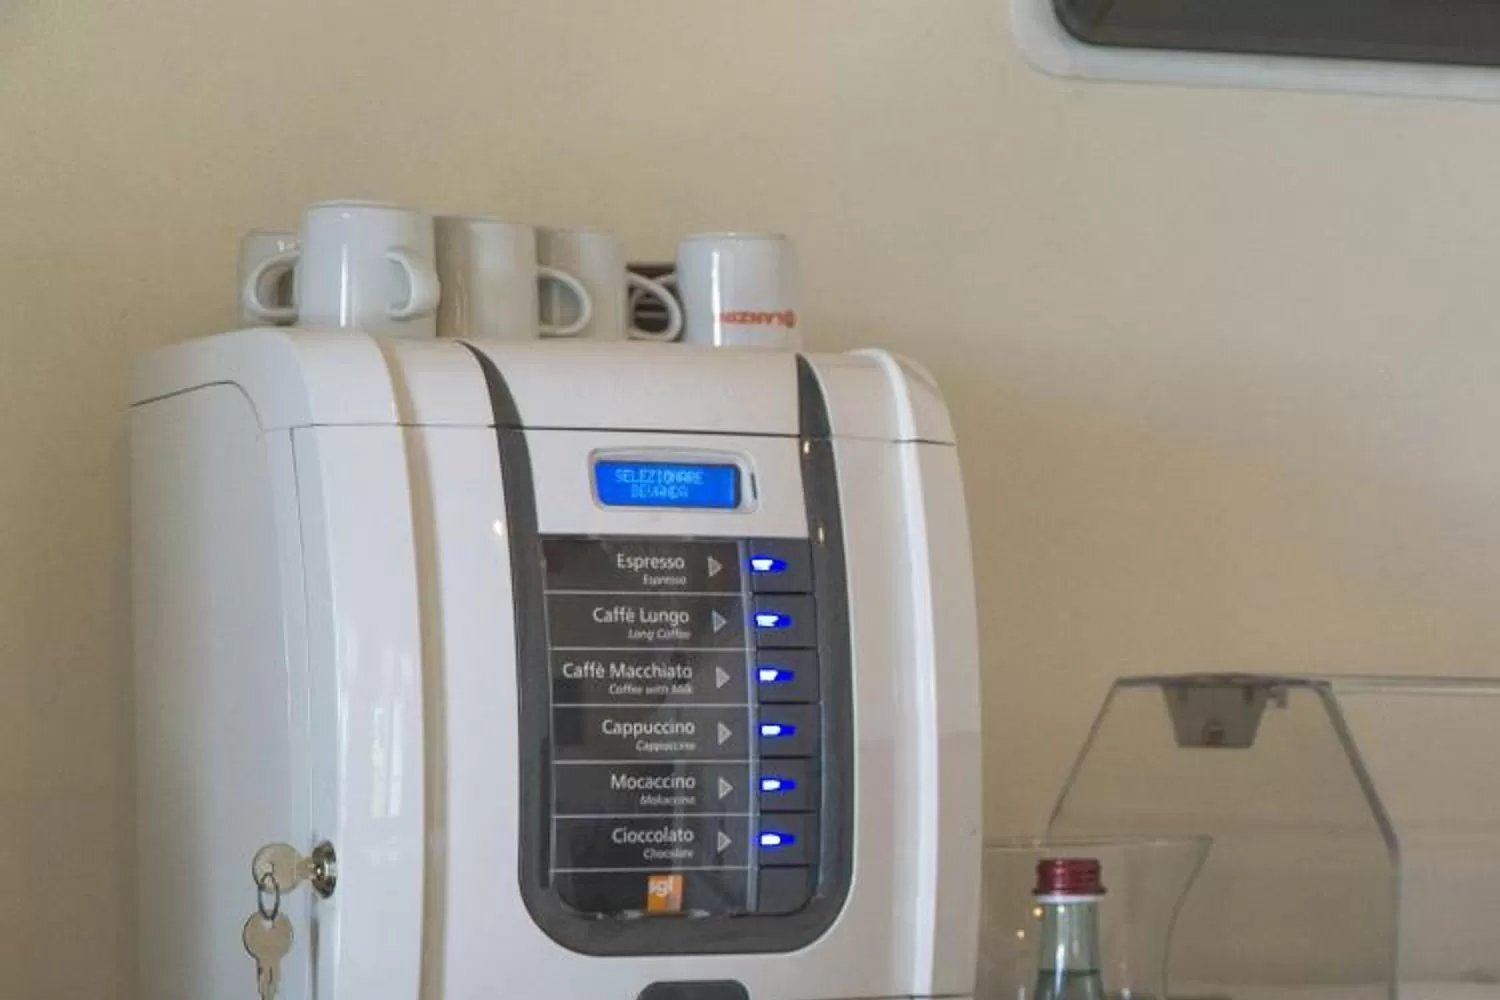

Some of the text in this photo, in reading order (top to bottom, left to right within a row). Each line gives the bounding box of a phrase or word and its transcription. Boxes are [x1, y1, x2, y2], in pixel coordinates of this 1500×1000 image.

[616, 552, 685, 572] Espresso
[592, 605, 690, 627] Caffè Lungo
[628, 628, 655, 641] Long
[562, 660, 693, 679] Caffè Macchiato
[608, 683, 642, 695] Coffee
[601, 718, 696, 739] Cappuccino
[610, 773, 696, 790] Mocaccino
[612, 826, 694, 843] Cioccolato
